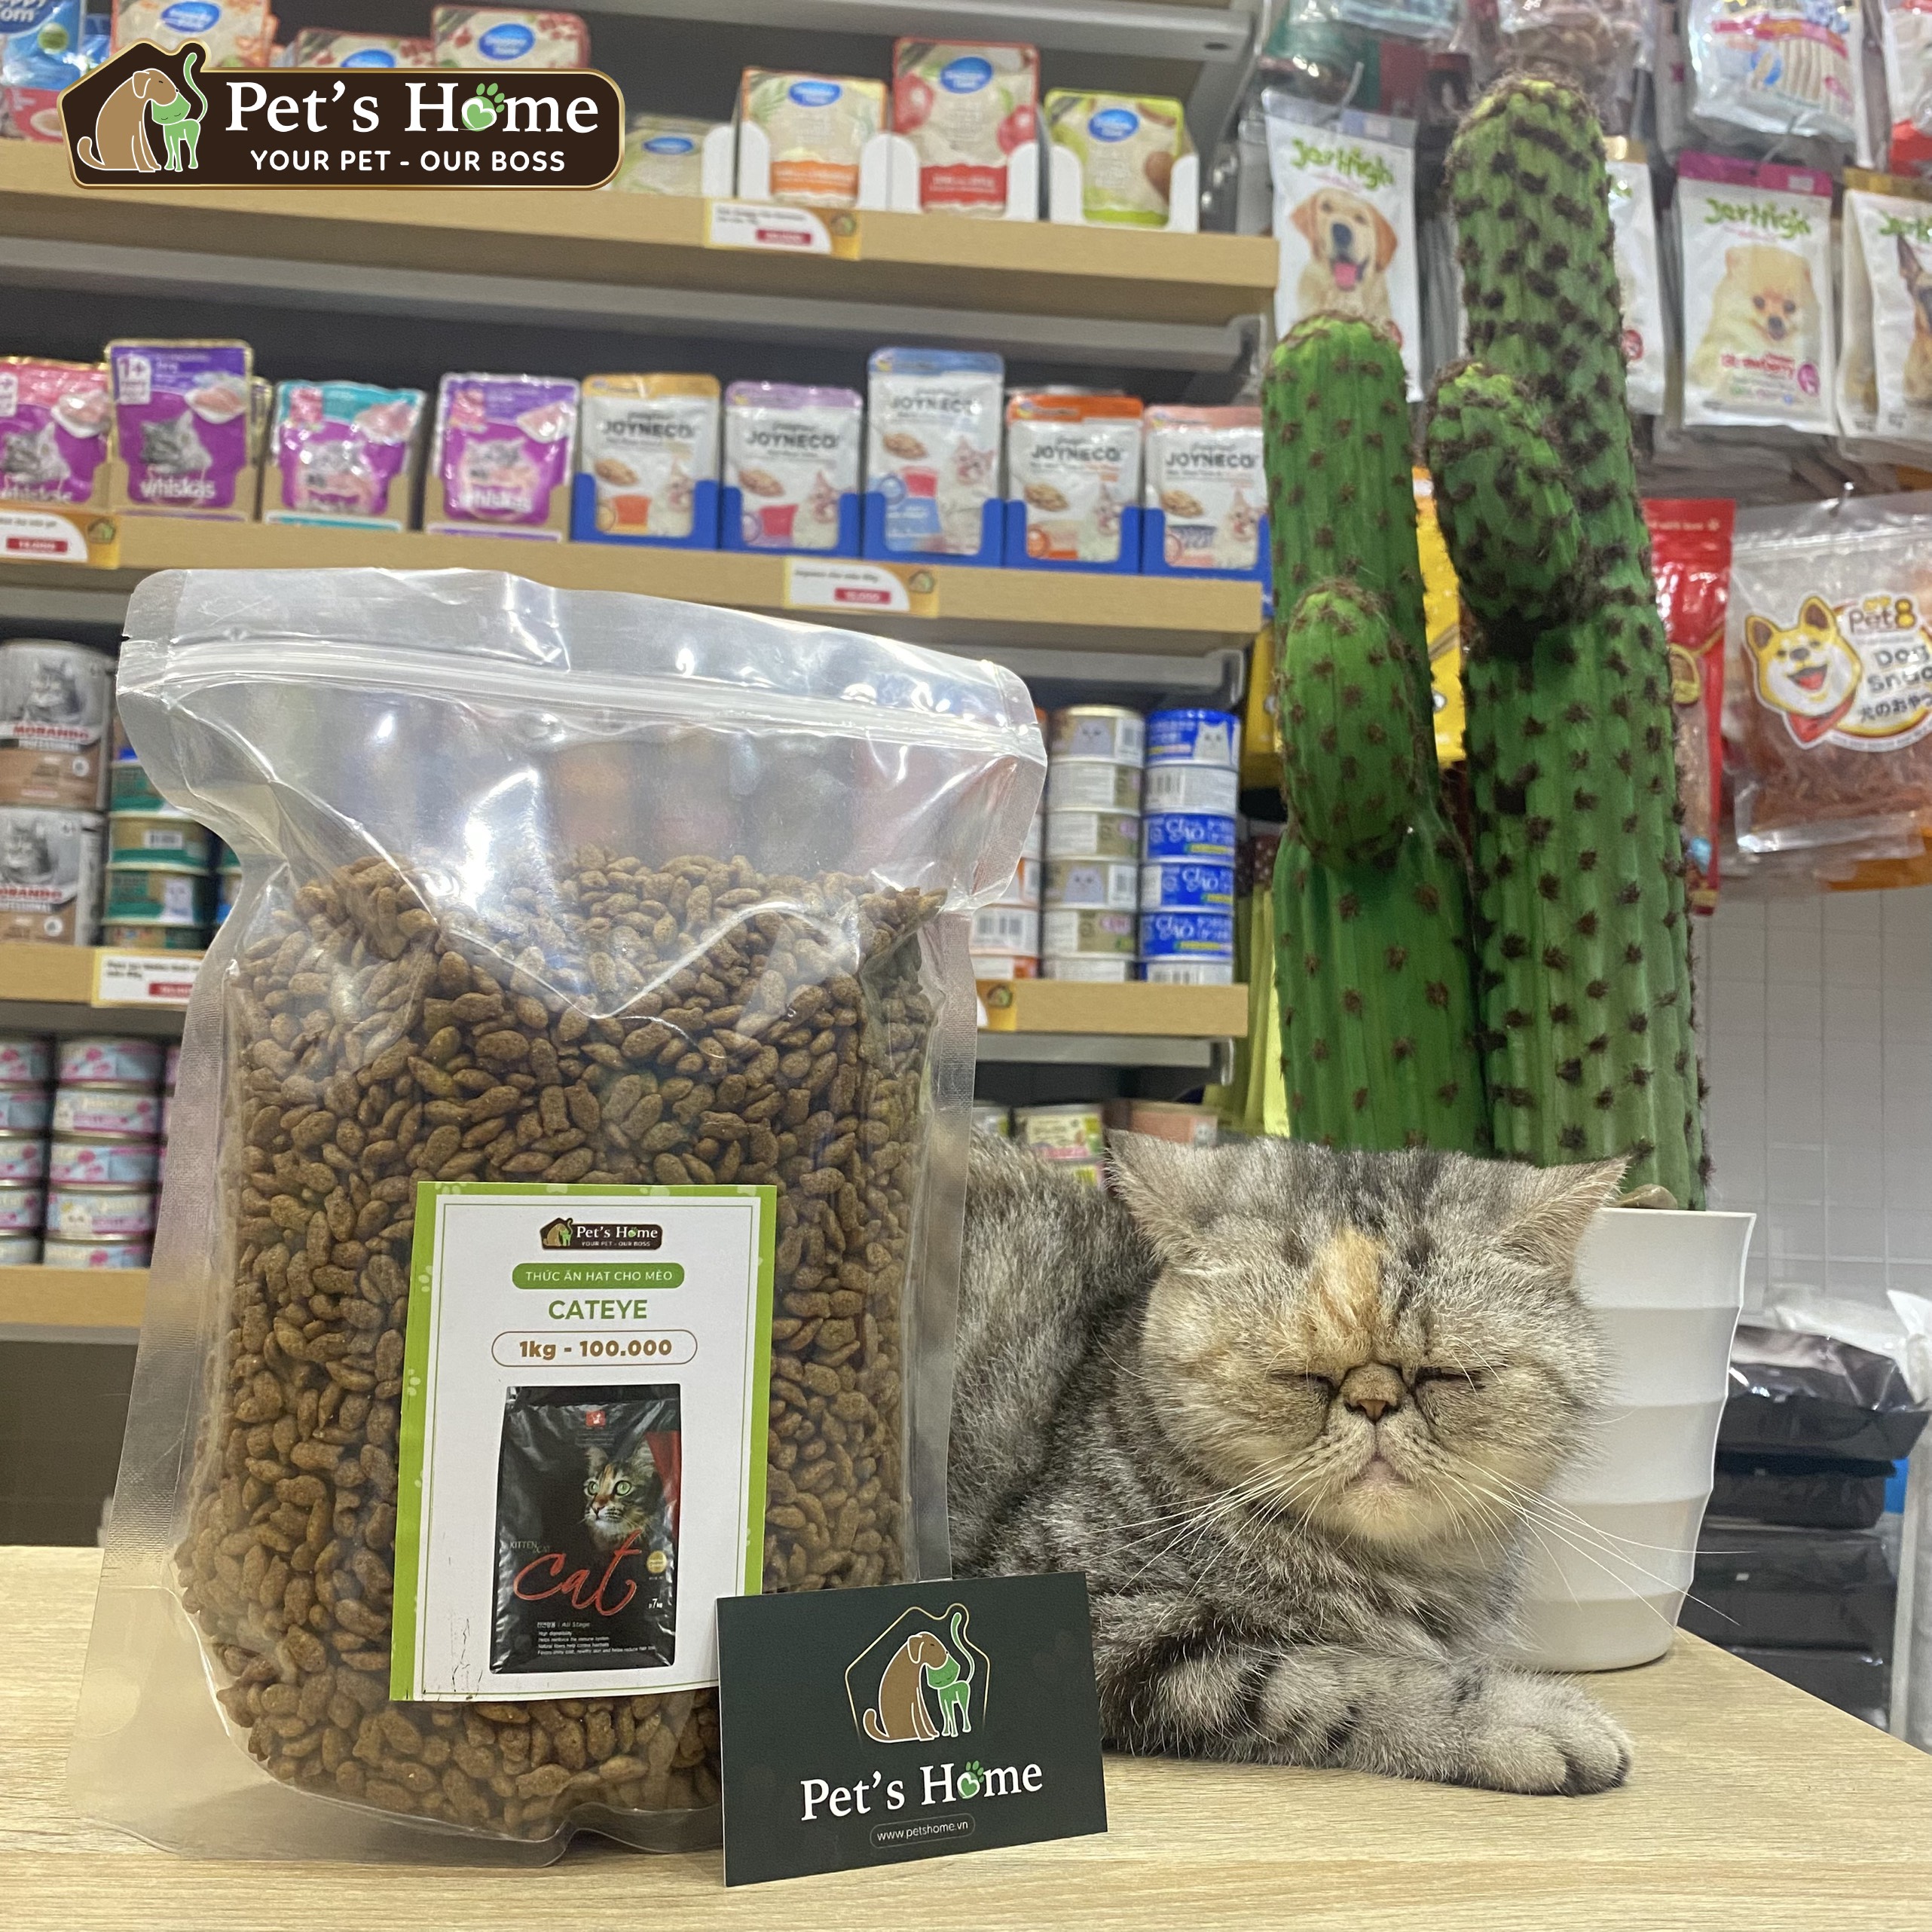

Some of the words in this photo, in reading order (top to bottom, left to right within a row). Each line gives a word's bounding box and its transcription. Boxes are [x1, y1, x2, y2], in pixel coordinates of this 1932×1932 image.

[603, 420, 695, 439] JOYNECO
[746, 430, 838, 450] JOYNECO
[1032, 445, 1121, 462] JOYNECO
[1166, 452, 1256, 469] JOYNECO
[139, 476, 216, 499] whiskas
[576, 1226, 611, 1239] Pet's
[616, 1226, 658, 1239] Home
[526, 1269, 561, 1282] THỨC
[564, 1269, 582, 1281] ĂN
[614, 1270, 641, 1281] CHO
[645, 1270, 673, 1281] MÈO
[548, 1299, 648, 1319] CATEYE
[519, 1340, 556, 1361] 1kg
[579, 1339, 672, 1357] 100.000
[800, 1770, 905, 1821] Pet's
[919, 1760, 1044, 1805] Home
[876, 1820, 969, 1841] www.petshome.vn
